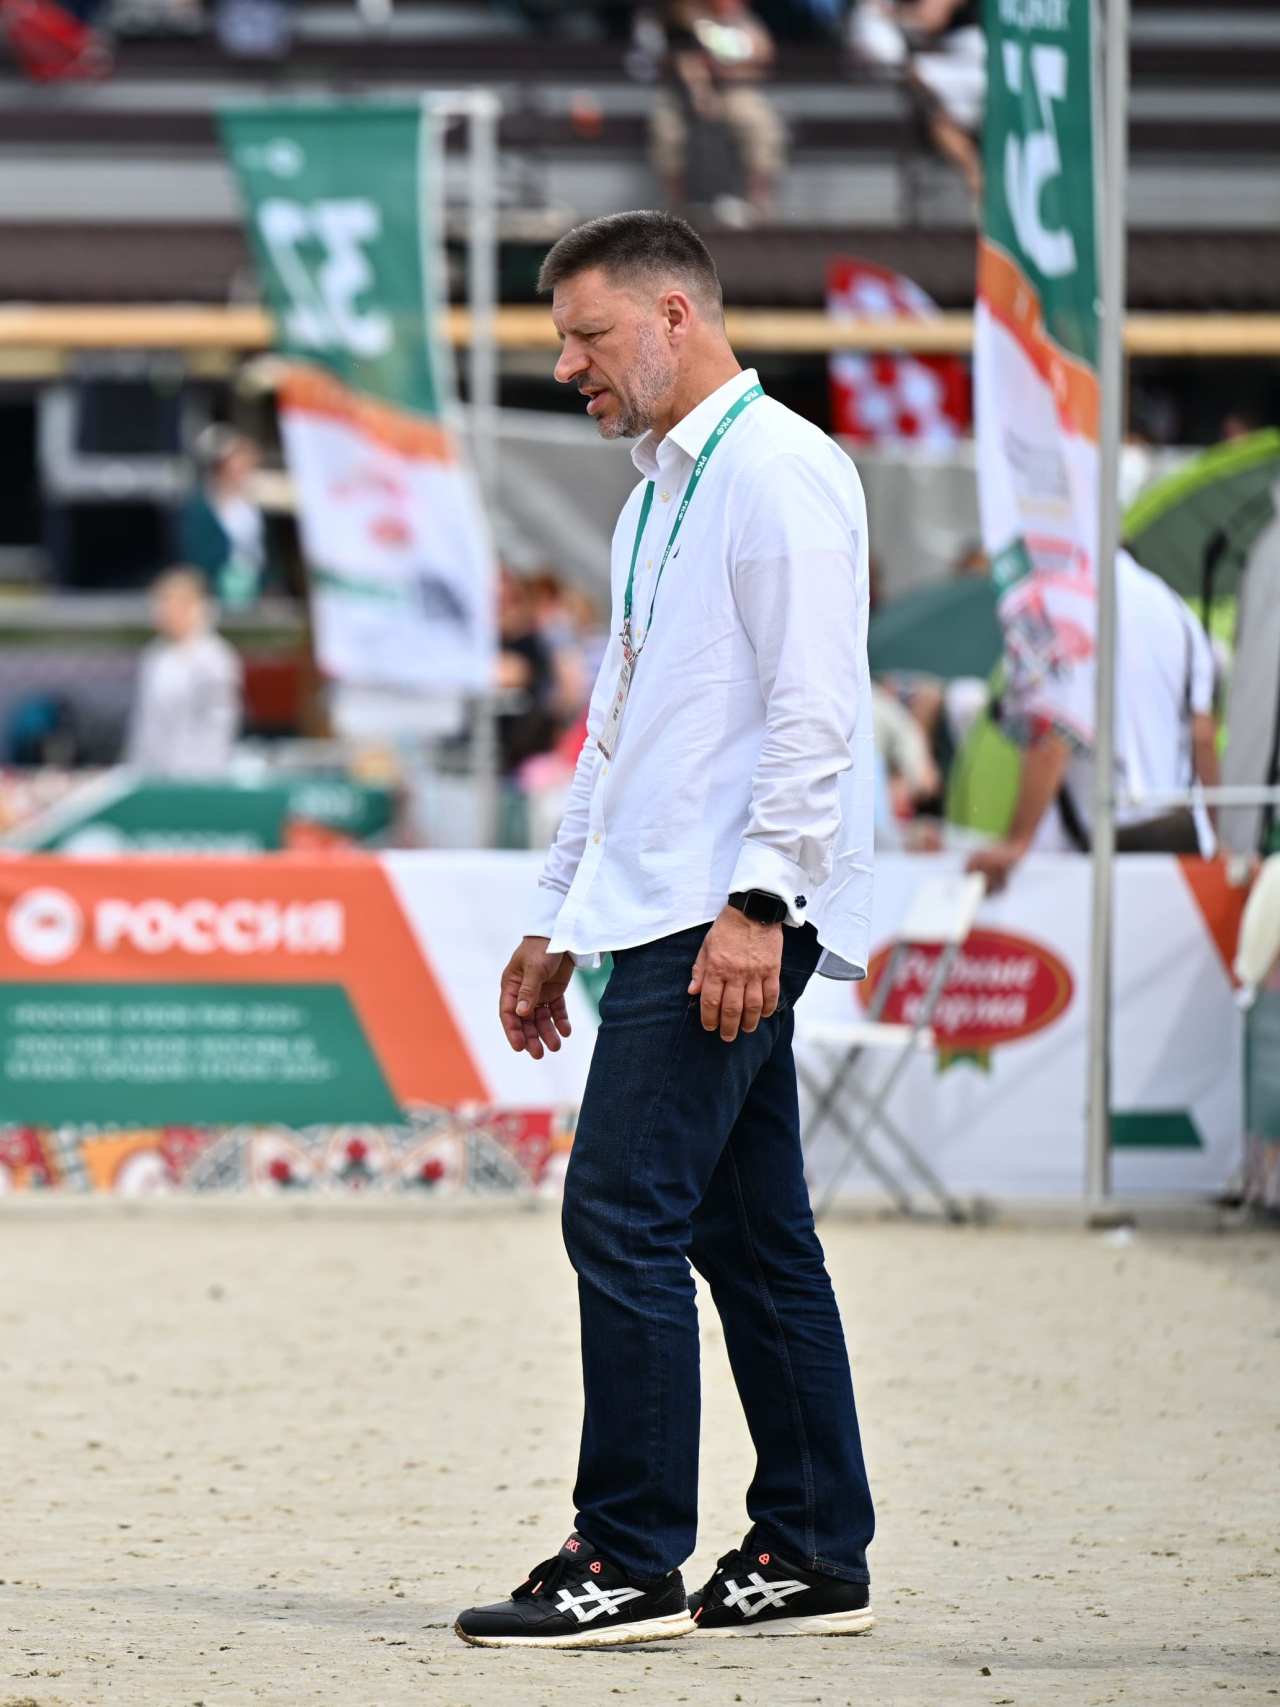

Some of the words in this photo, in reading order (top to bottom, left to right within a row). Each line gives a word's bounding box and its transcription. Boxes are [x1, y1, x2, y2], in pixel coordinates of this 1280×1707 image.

[716, 416, 733, 436] РКФ
[695, 455, 708, 477] РКФ
[95, 898, 345, 954] РОССИЯ
